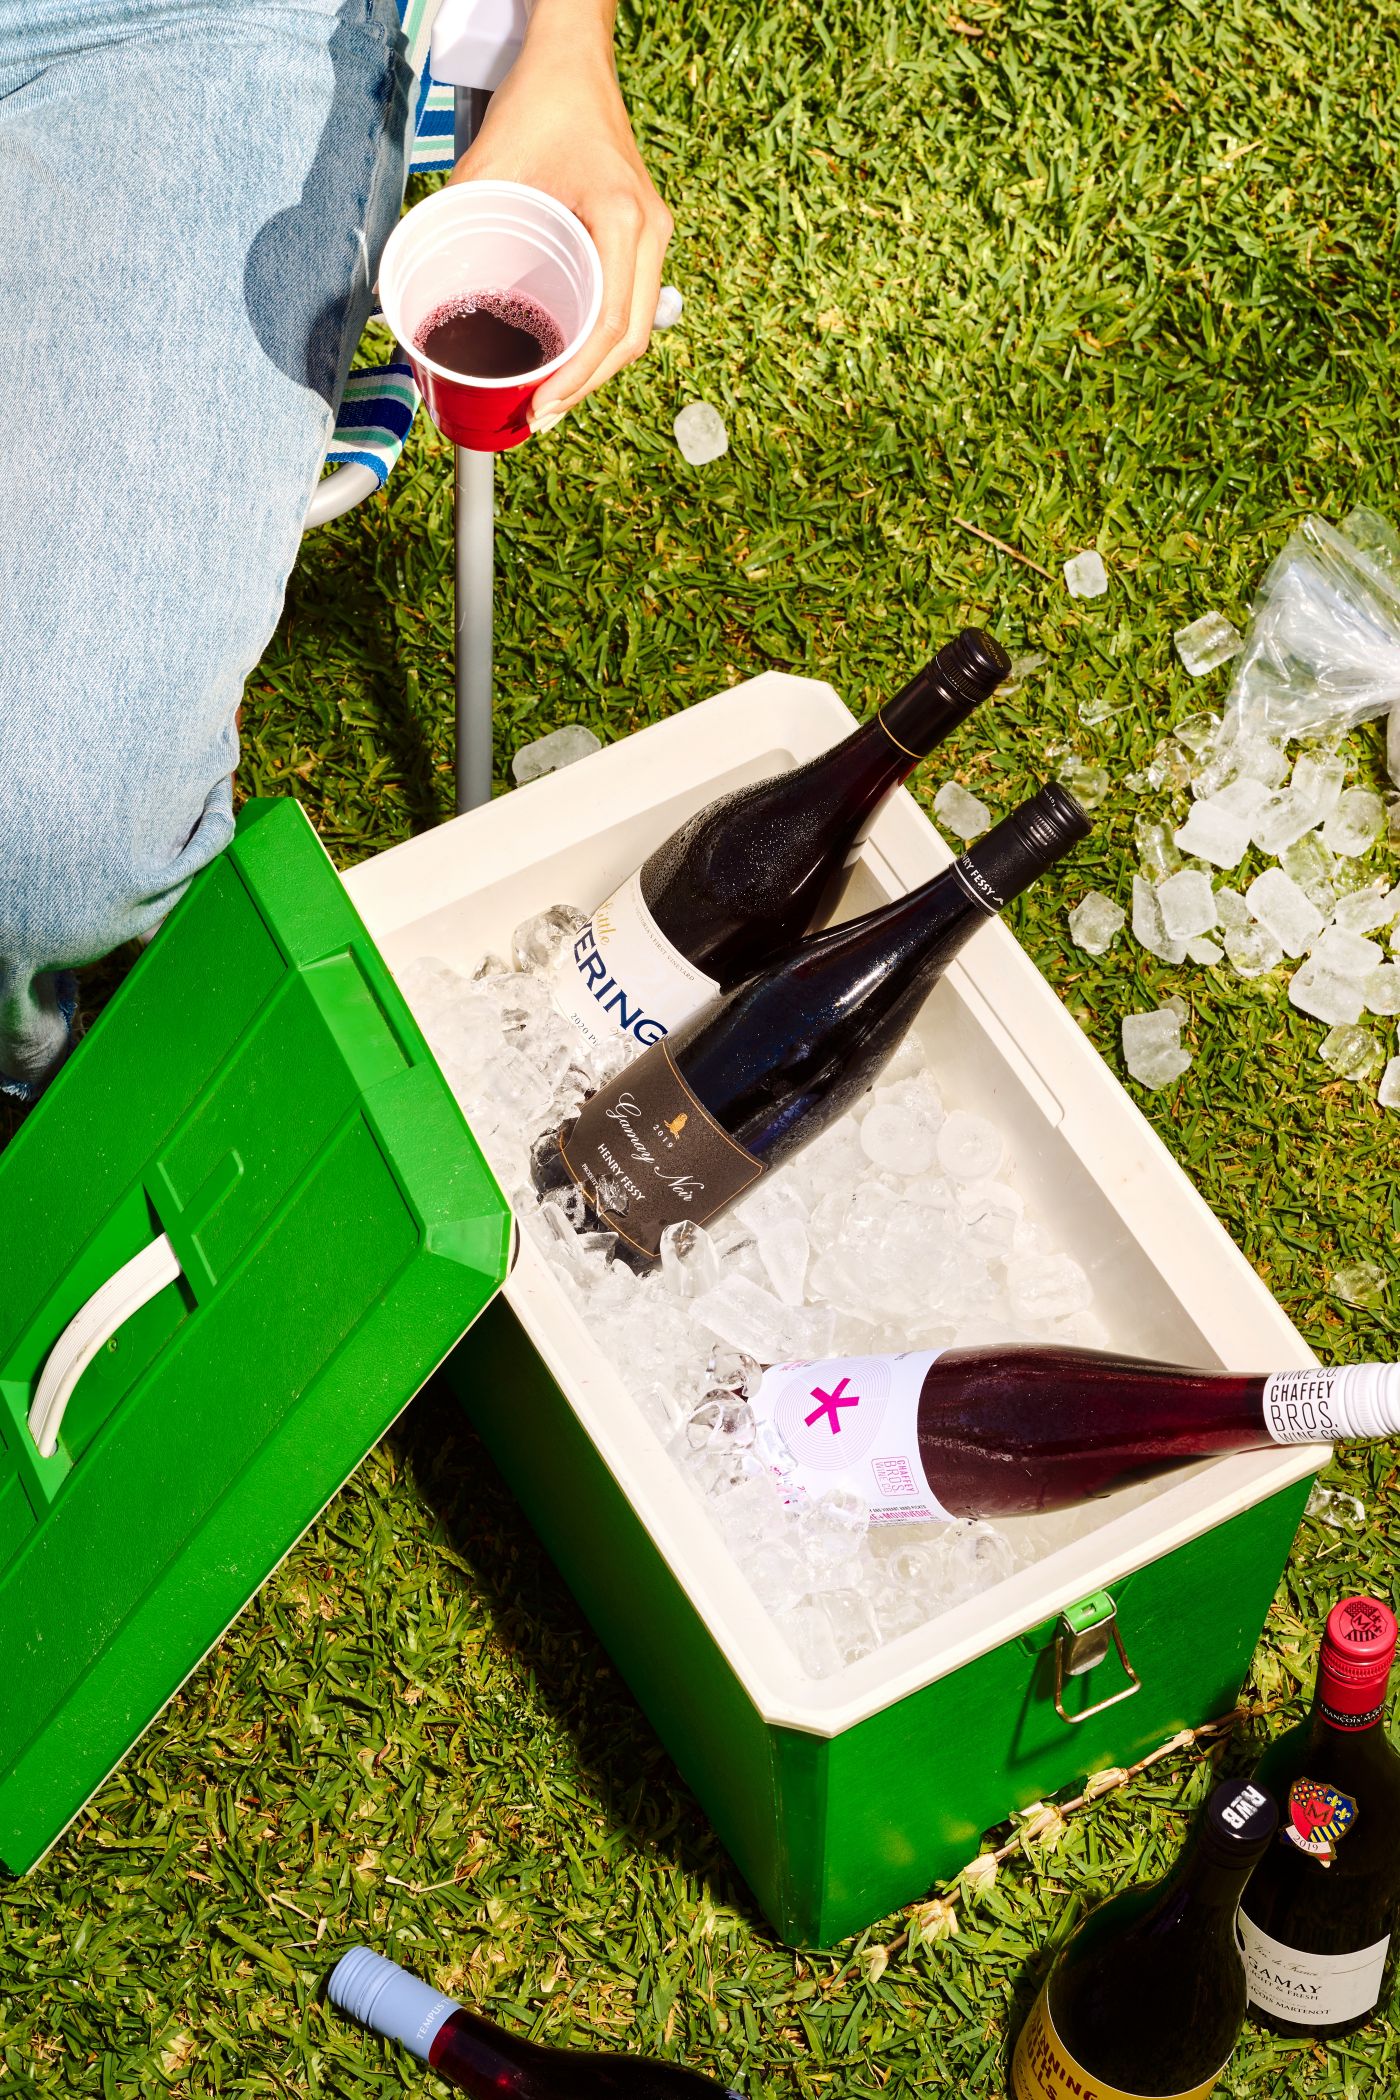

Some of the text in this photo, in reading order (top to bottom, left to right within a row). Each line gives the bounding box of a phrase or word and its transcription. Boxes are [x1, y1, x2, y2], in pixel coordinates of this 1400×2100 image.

[970, 869, 996, 896] FESSY
[652, 937, 668, 955] FIRST
[667, 953, 695, 981] VINEYARD
[571, 1013, 589, 1035] 2020
[606, 1092, 705, 1202] Gamay Noir
[653, 1124, 674, 1148] 2019
[597, 1143, 645, 1201] HENRY FESSY
[1276, 1368, 1312, 1381] WINE
[1270, 1380, 1334, 1402] CHAFFEY
[1270, 1400, 1338, 1432] BROS.
[896, 1460, 915, 1492] CHAFFEY
[1293, 1834, 1319, 1852] 2019
[1247, 1955, 1323, 1994] GAMAY
[1250, 1968, 1274, 1987] IGHT
[1287, 1989, 1319, 2001] FRESH
[416, 2000, 446, 2040] TEMPUS
[1275, 2001, 1330, 2015] MARTENOT
